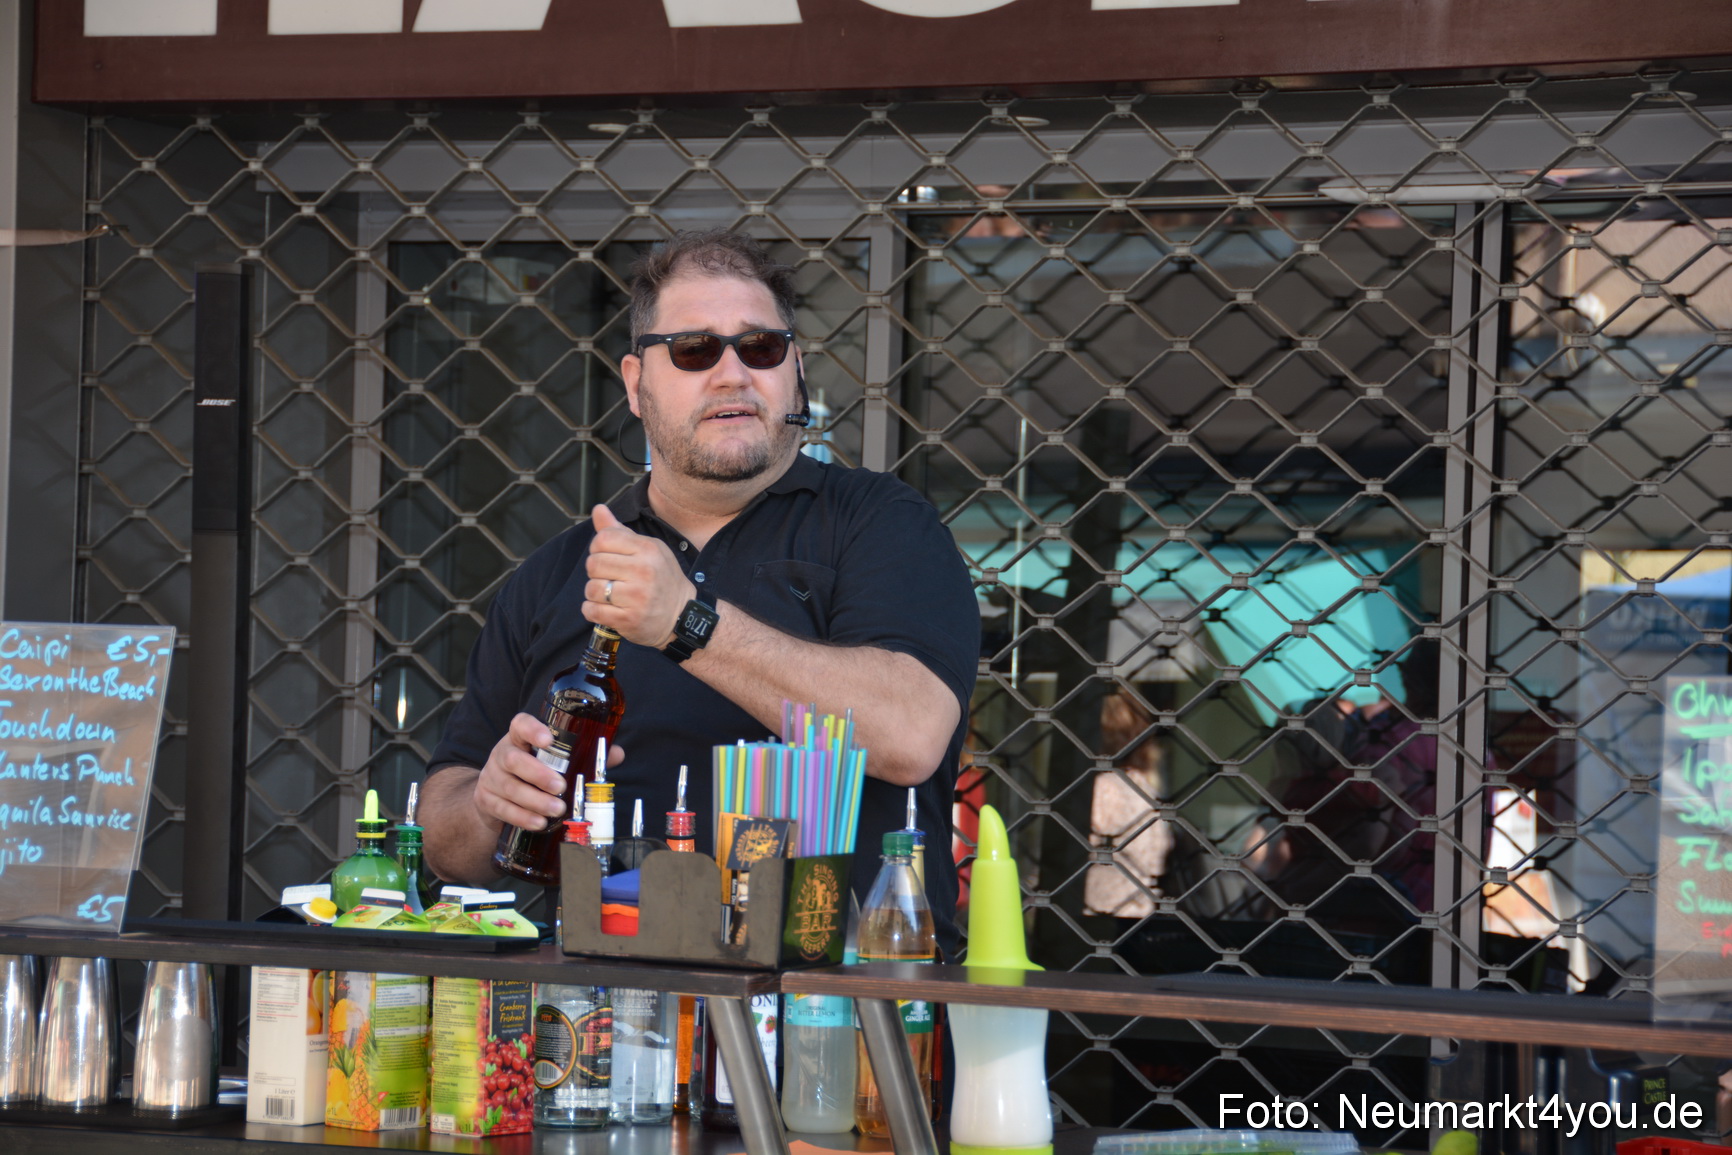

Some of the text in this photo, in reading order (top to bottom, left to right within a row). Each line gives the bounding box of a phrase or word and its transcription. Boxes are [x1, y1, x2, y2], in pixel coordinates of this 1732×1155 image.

[66, 666, 101, 693] the
[103, 667, 156, 701] Beach
[76, 754, 134, 786] Punch
[58, 796, 132, 831] Sunrise
[1643, 1078, 1666, 1091] PRINCE
